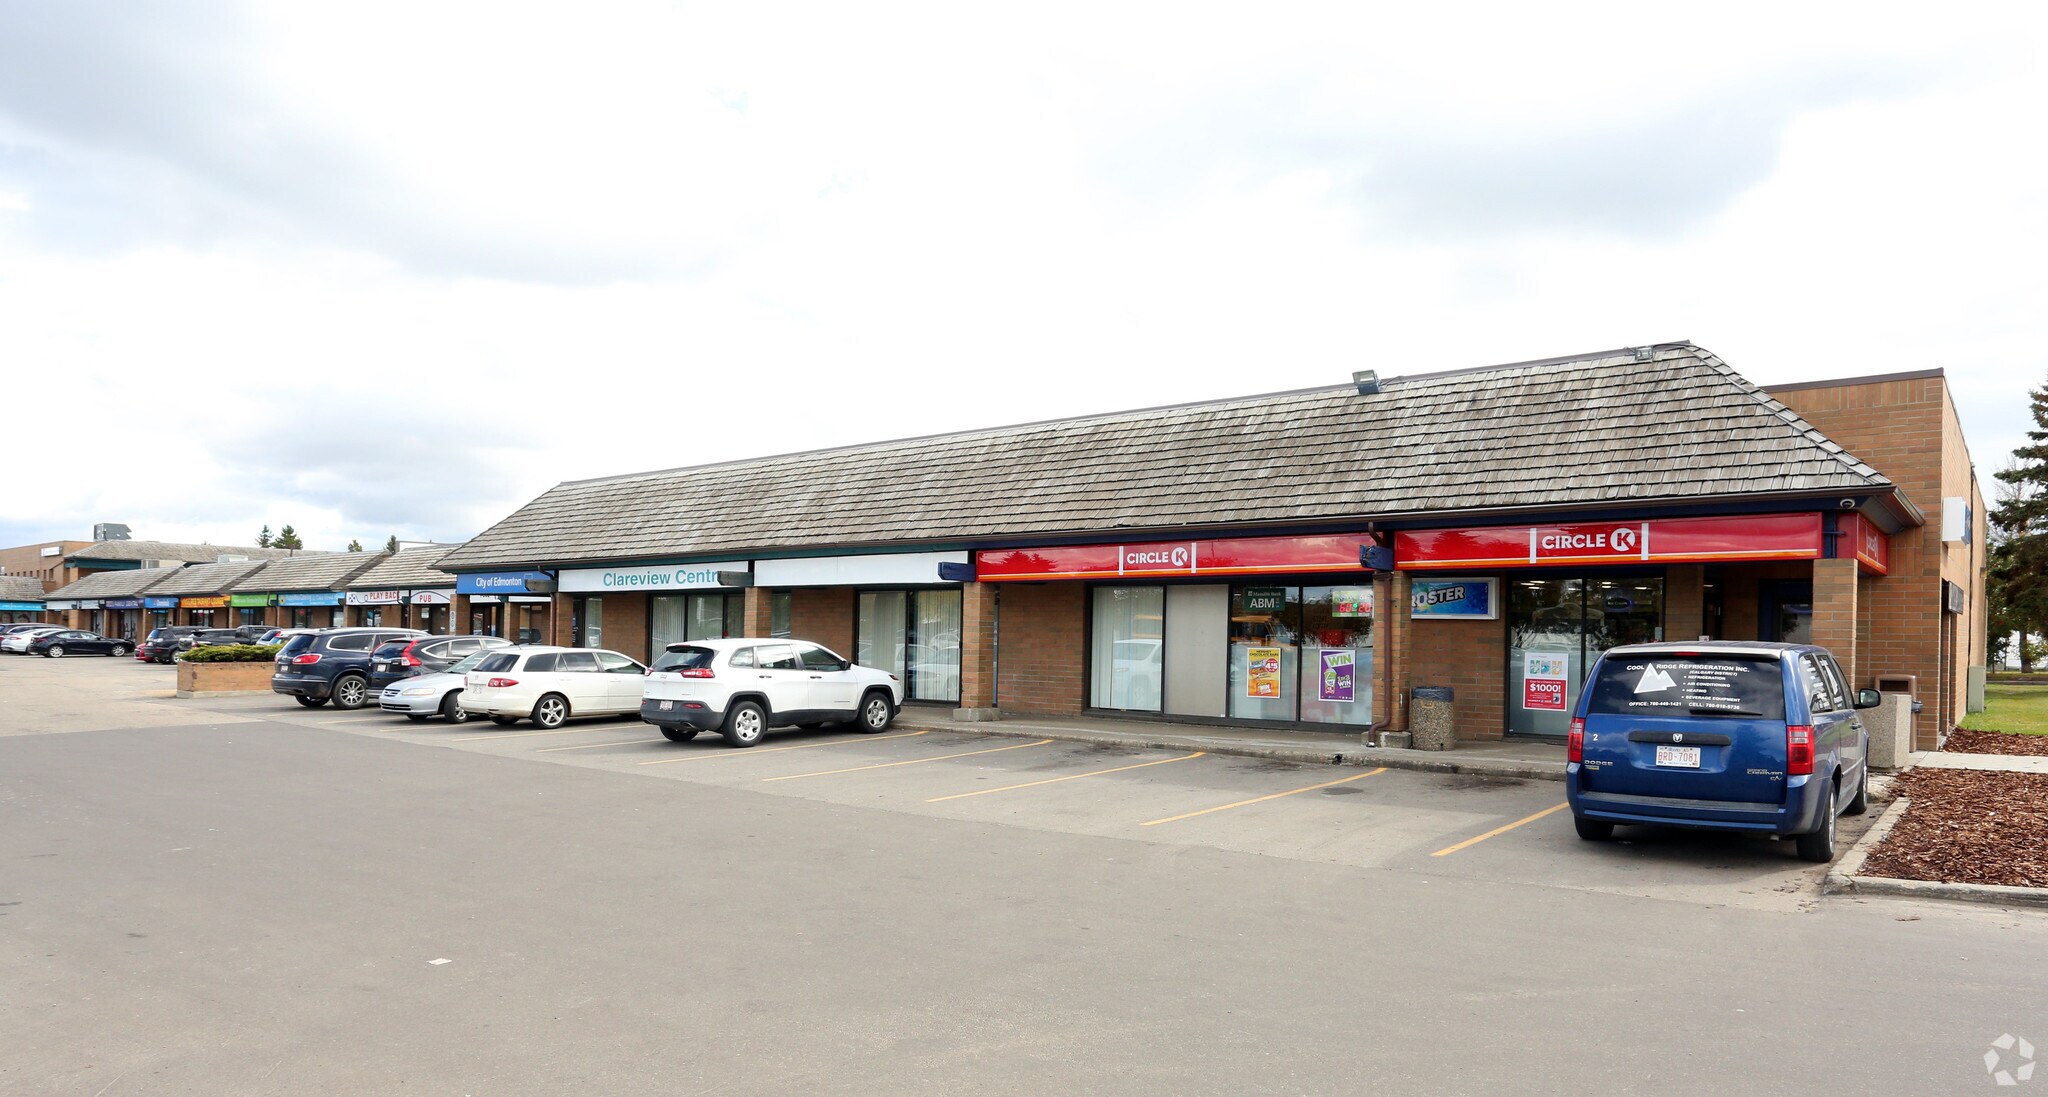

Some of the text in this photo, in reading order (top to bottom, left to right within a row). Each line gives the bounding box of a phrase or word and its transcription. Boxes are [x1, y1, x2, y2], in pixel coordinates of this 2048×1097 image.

[1541, 530, 1634, 550] CIRCLE K
[1126, 551, 1169, 564] CIRCLE
[476, 576, 522, 588] City of Edmonton
[603, 569, 718, 586] Clareview Centr
[370, 592, 385, 600] PLAY
[1249, 598, 1275, 608] ABM
[1328, 654, 1352, 666] WIN
[1679, 663, 1734, 672] REFRIGERATION
[1530, 682, 1561, 692] $1000!
[1658, 752, 1698, 762] BRD-7081
